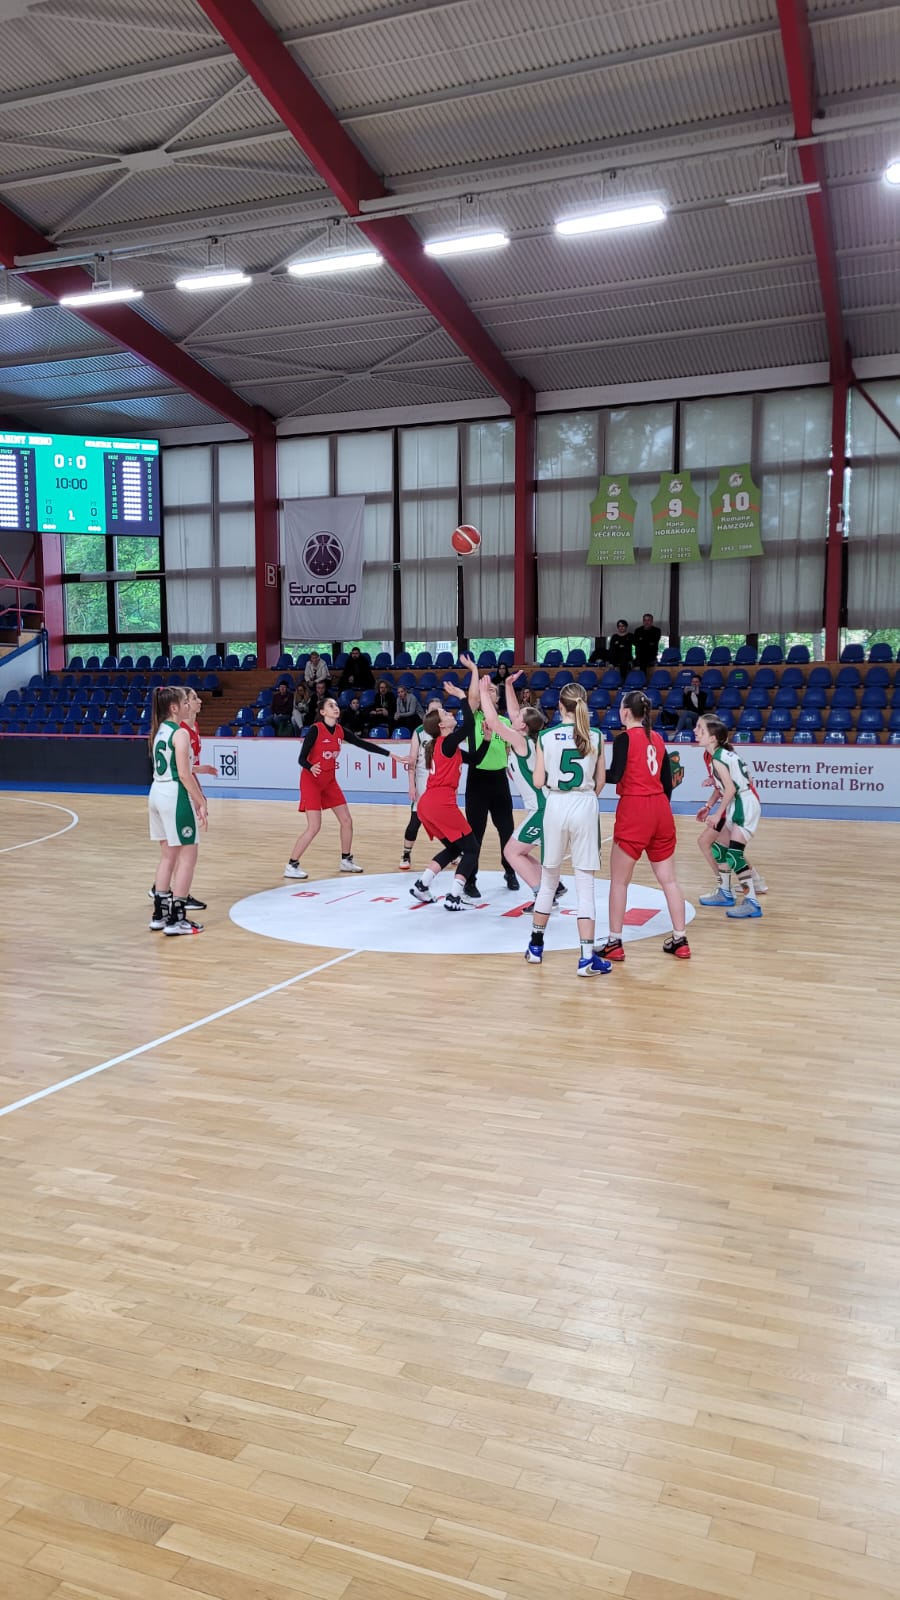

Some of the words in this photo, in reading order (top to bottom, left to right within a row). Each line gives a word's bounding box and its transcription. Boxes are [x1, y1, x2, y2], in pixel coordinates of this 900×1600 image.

[56, 477, 88, 490] 10:00
[668, 498, 683, 518] 9
[721, 491, 750, 513] 10
[606, 502, 619, 521] 5
[267, 565, 276, 585] B
[289, 581, 357, 598] EuroCup
[290, 596, 349, 605] women
[155, 740, 168, 776] 6
[646, 744, 659, 776] 8
[219, 766, 237, 776] TOI
[558, 748, 585, 791] 5
[752, 760, 811, 774] Western
[816, 761, 874, 775] Premier
[849, 779, 885, 792] Brno
[526, 826, 541, 836] 15
